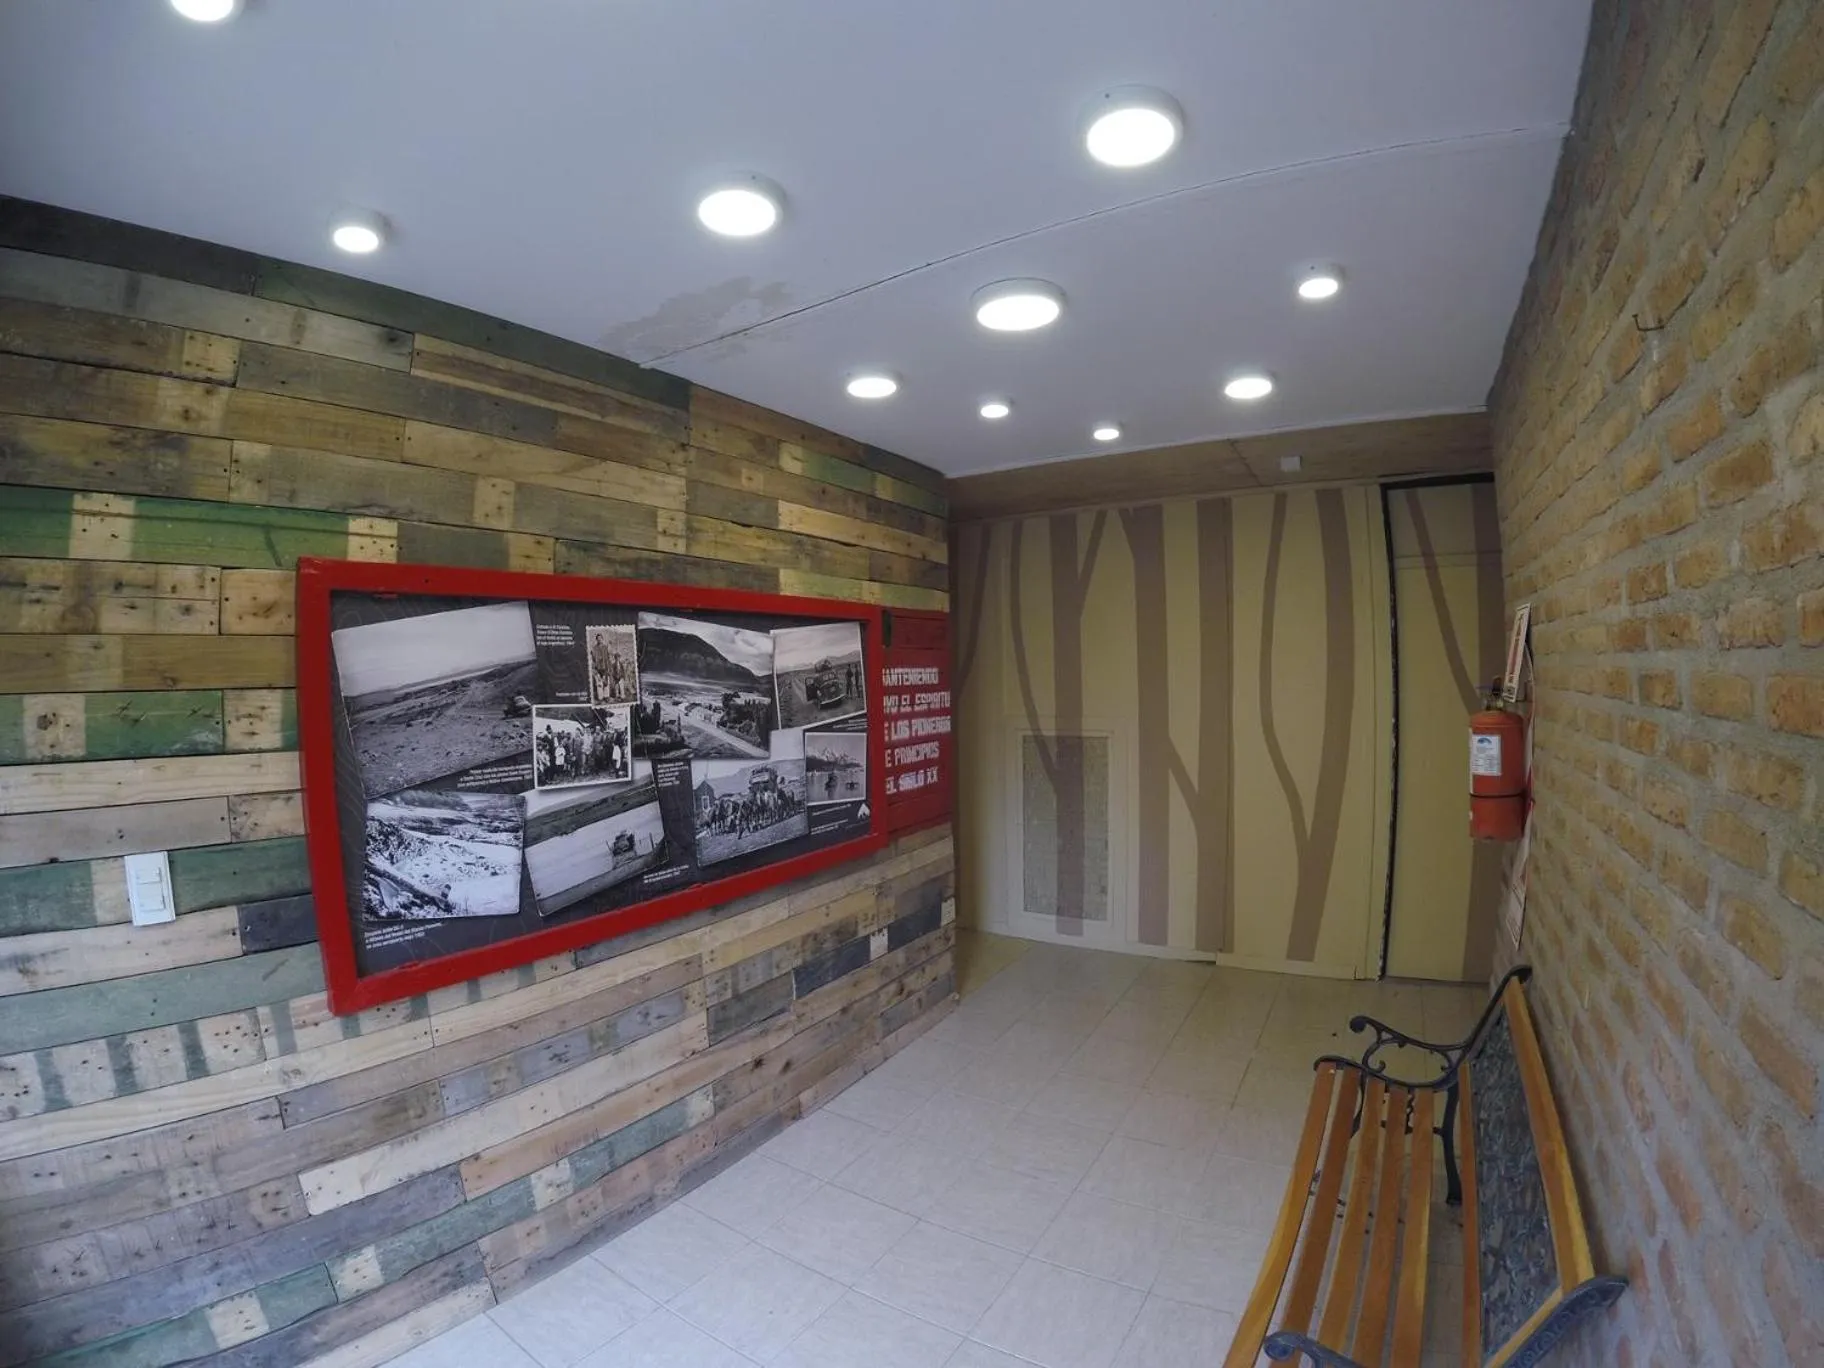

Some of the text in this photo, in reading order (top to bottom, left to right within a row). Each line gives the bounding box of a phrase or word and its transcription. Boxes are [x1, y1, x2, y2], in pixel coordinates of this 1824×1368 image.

[900, 694, 912, 712] EL
[891, 719, 910, 740] LOS
[926, 766, 938, 785] XX
